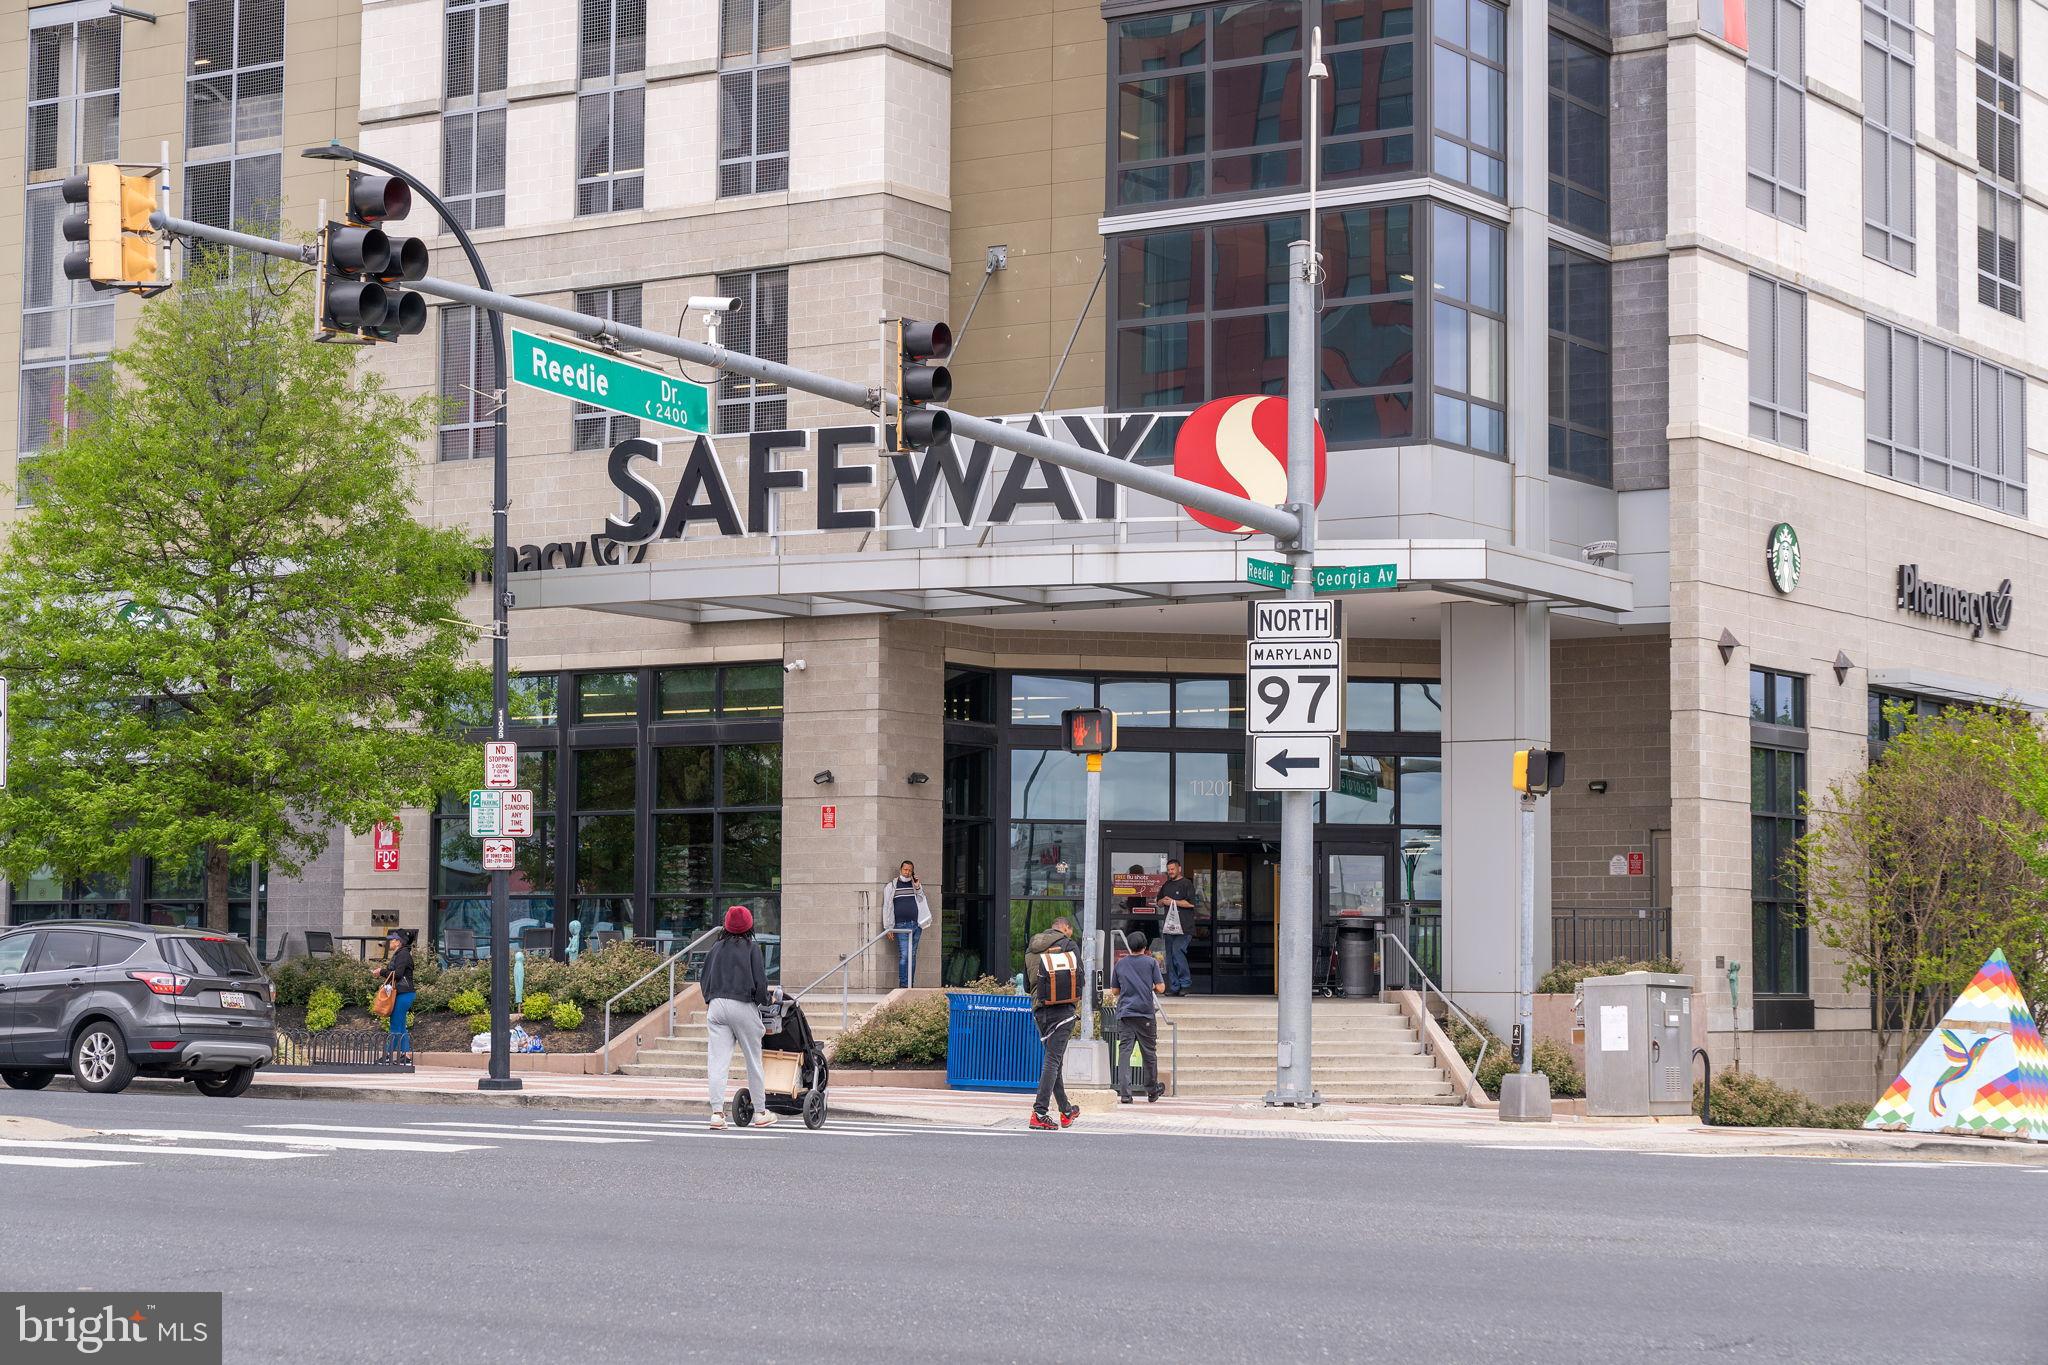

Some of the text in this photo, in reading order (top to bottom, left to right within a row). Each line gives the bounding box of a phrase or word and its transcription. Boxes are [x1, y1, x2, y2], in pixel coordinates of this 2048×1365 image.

[532, 346, 683, 406] Reedie Dr.
[605, 412, 1160, 543] SAFEWAY
[1248, 562, 1274, 582] Reedie
[1317, 568, 1393, 589] Georgia Av
[1898, 563, 1990, 638] Pharmacy
[1260, 608, 1328, 632] NORTH
[1254, 648, 1332, 661] MARYLAND
[1257, 675, 1331, 725] 97
[495, 745, 506, 755] NO
[1191, 780, 1233, 797] 11201
[472, 793, 480, 806] 2
[481, 799, 499, 807] PARKING
[511, 794, 522, 803] NO
[377, 851, 397, 863] FDC
